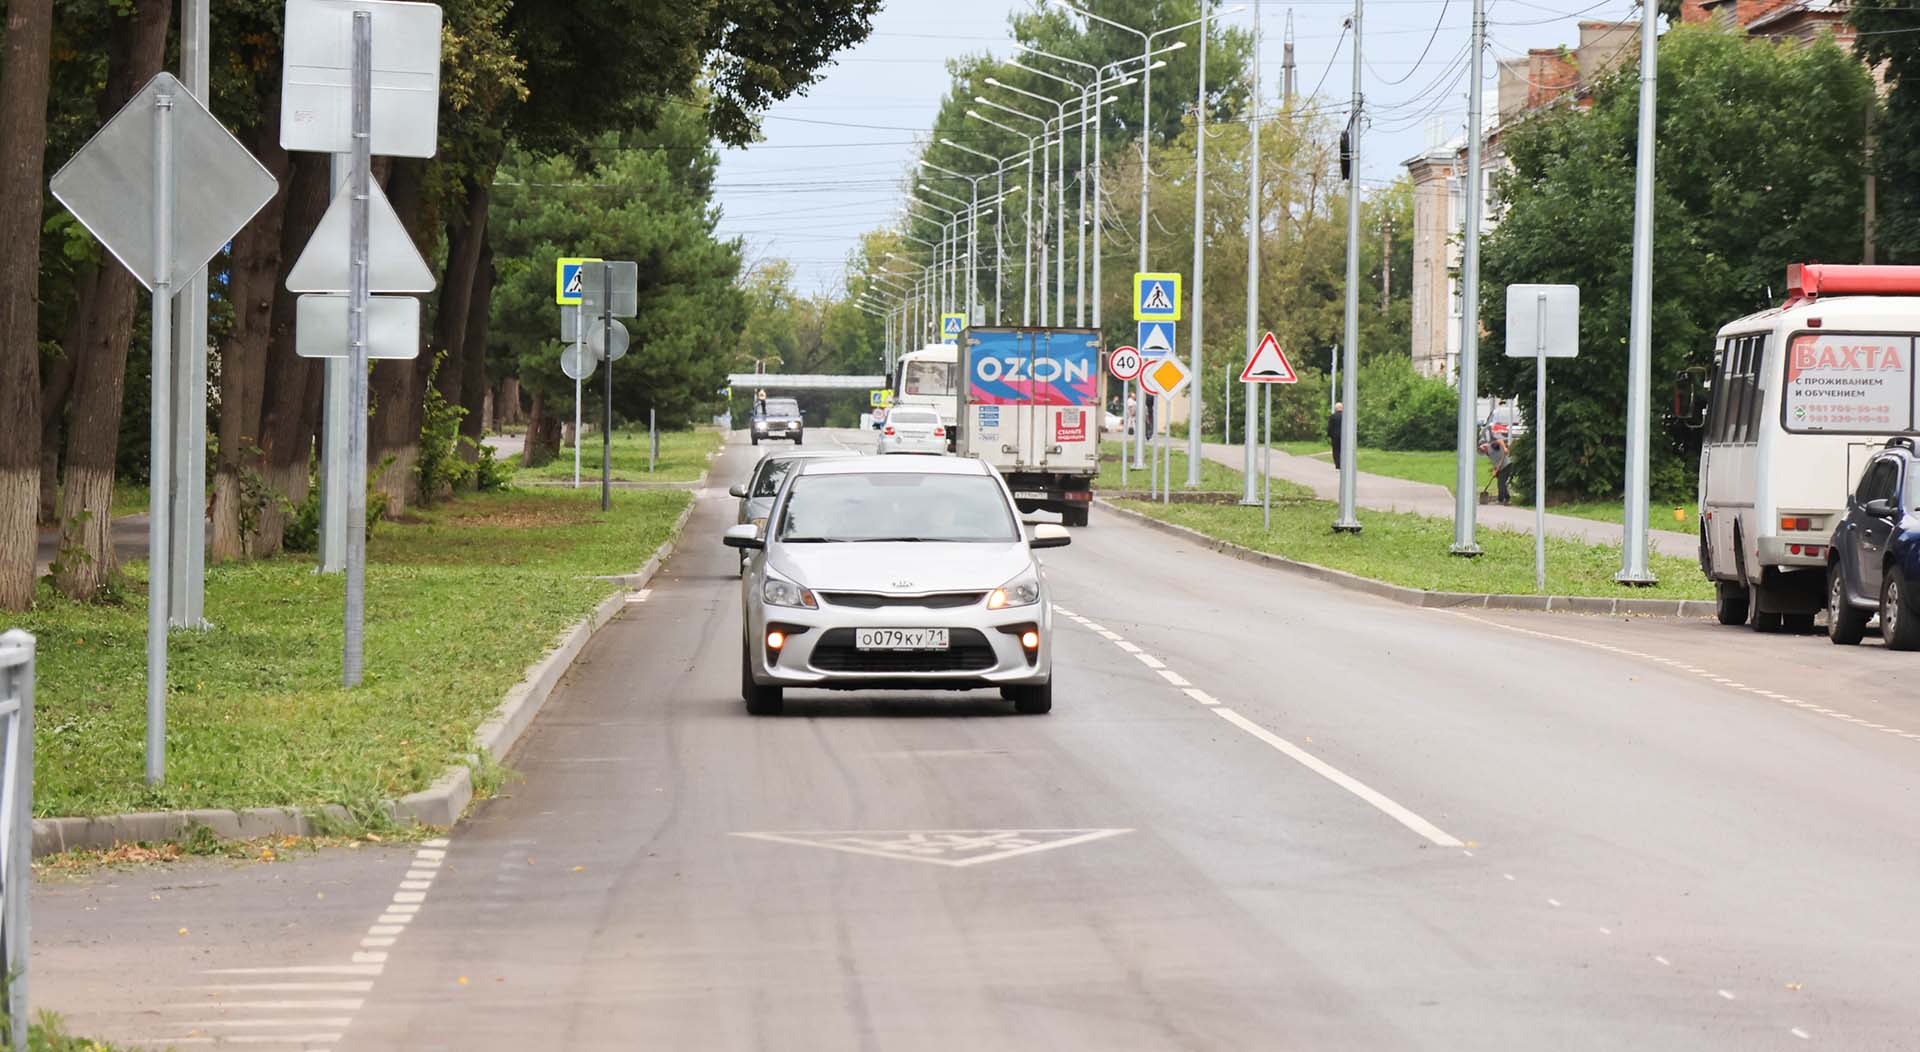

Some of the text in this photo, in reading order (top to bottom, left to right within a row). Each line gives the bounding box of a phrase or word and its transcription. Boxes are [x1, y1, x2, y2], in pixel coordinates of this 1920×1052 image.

[1116, 356, 1135, 369] 40
[1796, 344, 1903, 370] ВАХТА
[977, 356, 1088, 383] OZON
[1795, 377, 1883, 386] С ПРОЖИВАНИЕМ
[1795, 389, 1865, 397] И ОБУЧЕНИЕМ
[928, 630, 944, 641] 71
